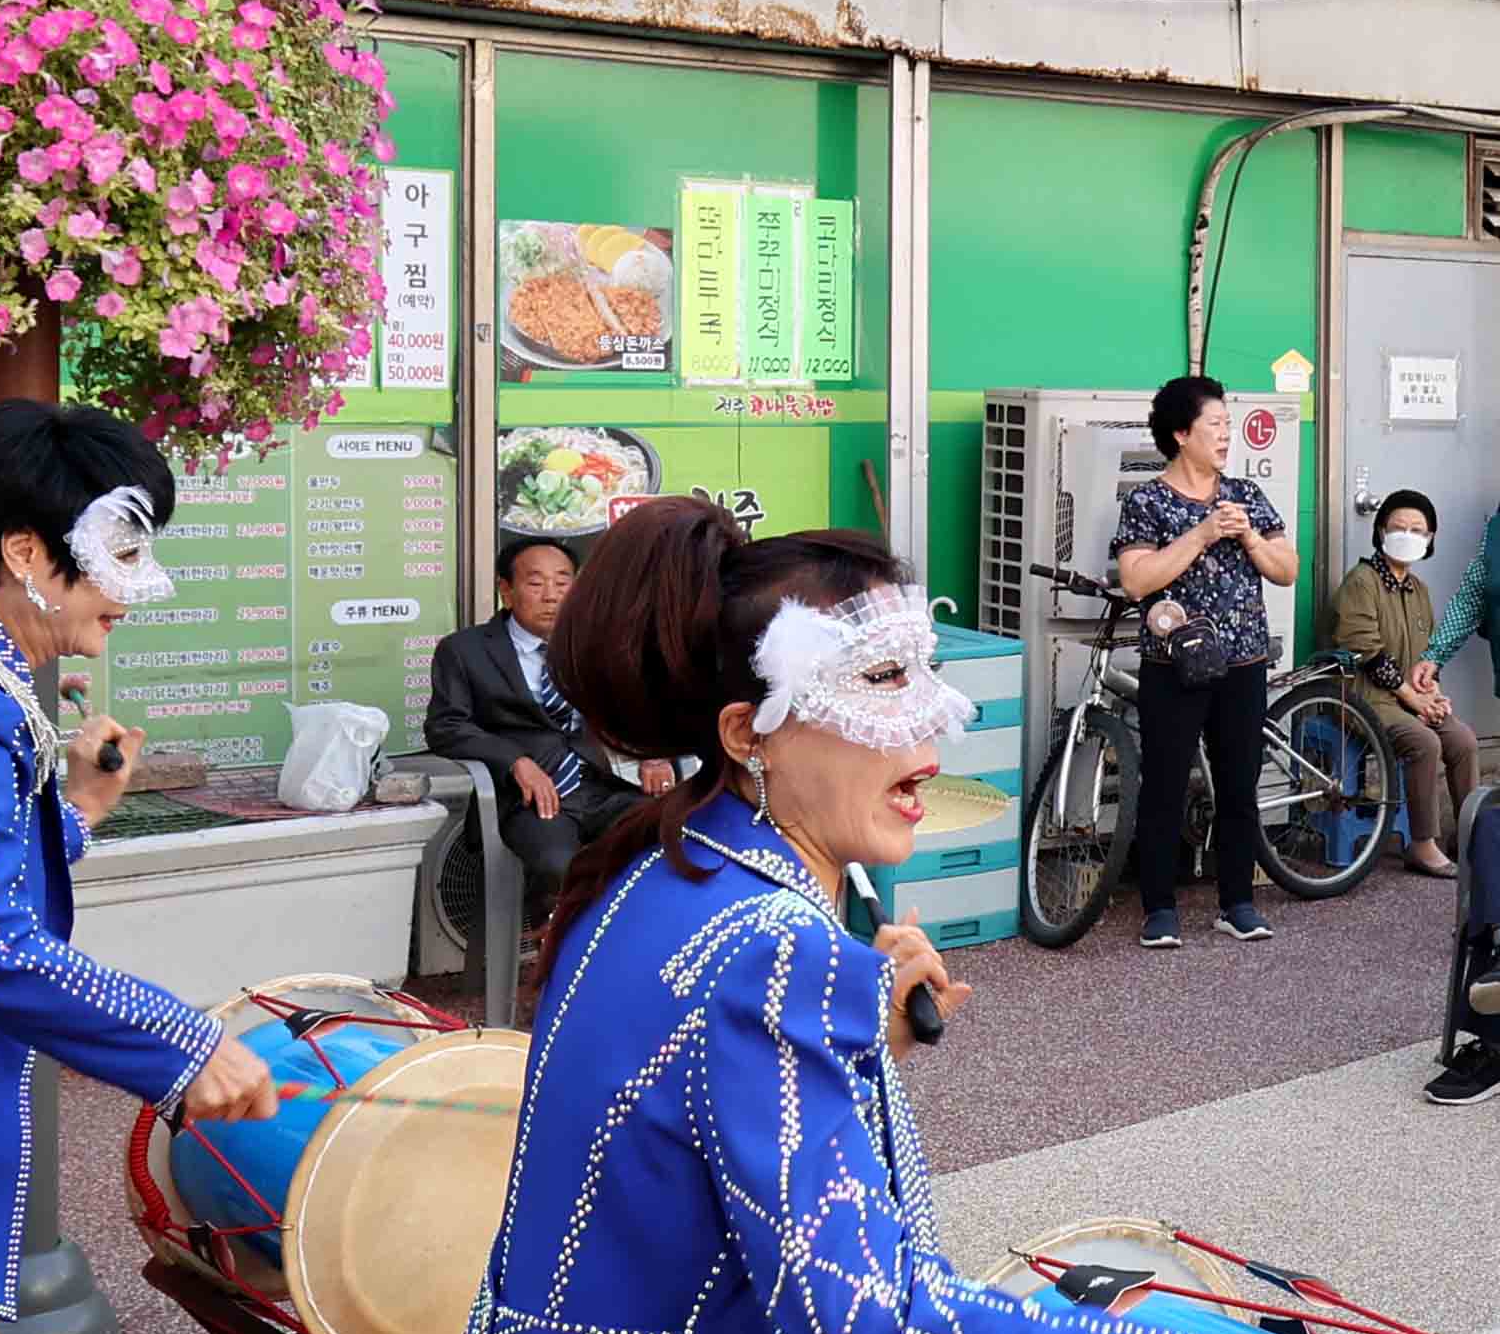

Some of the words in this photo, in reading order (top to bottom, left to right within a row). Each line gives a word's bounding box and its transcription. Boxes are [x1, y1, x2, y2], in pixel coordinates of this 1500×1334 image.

[403, 182, 430, 290] 아구찜
[397, 294, 436, 310] (예약)
[387, 333, 445, 351] 40,000원
[598, 335, 666, 353] 등심돈까스
[387, 364, 445, 382] 50,000원
[713, 395, 745, 417] 전주
[375, 440, 413, 452] MENU
[1245, 458, 1272, 478] LG
[372, 605, 410, 617] MENU
